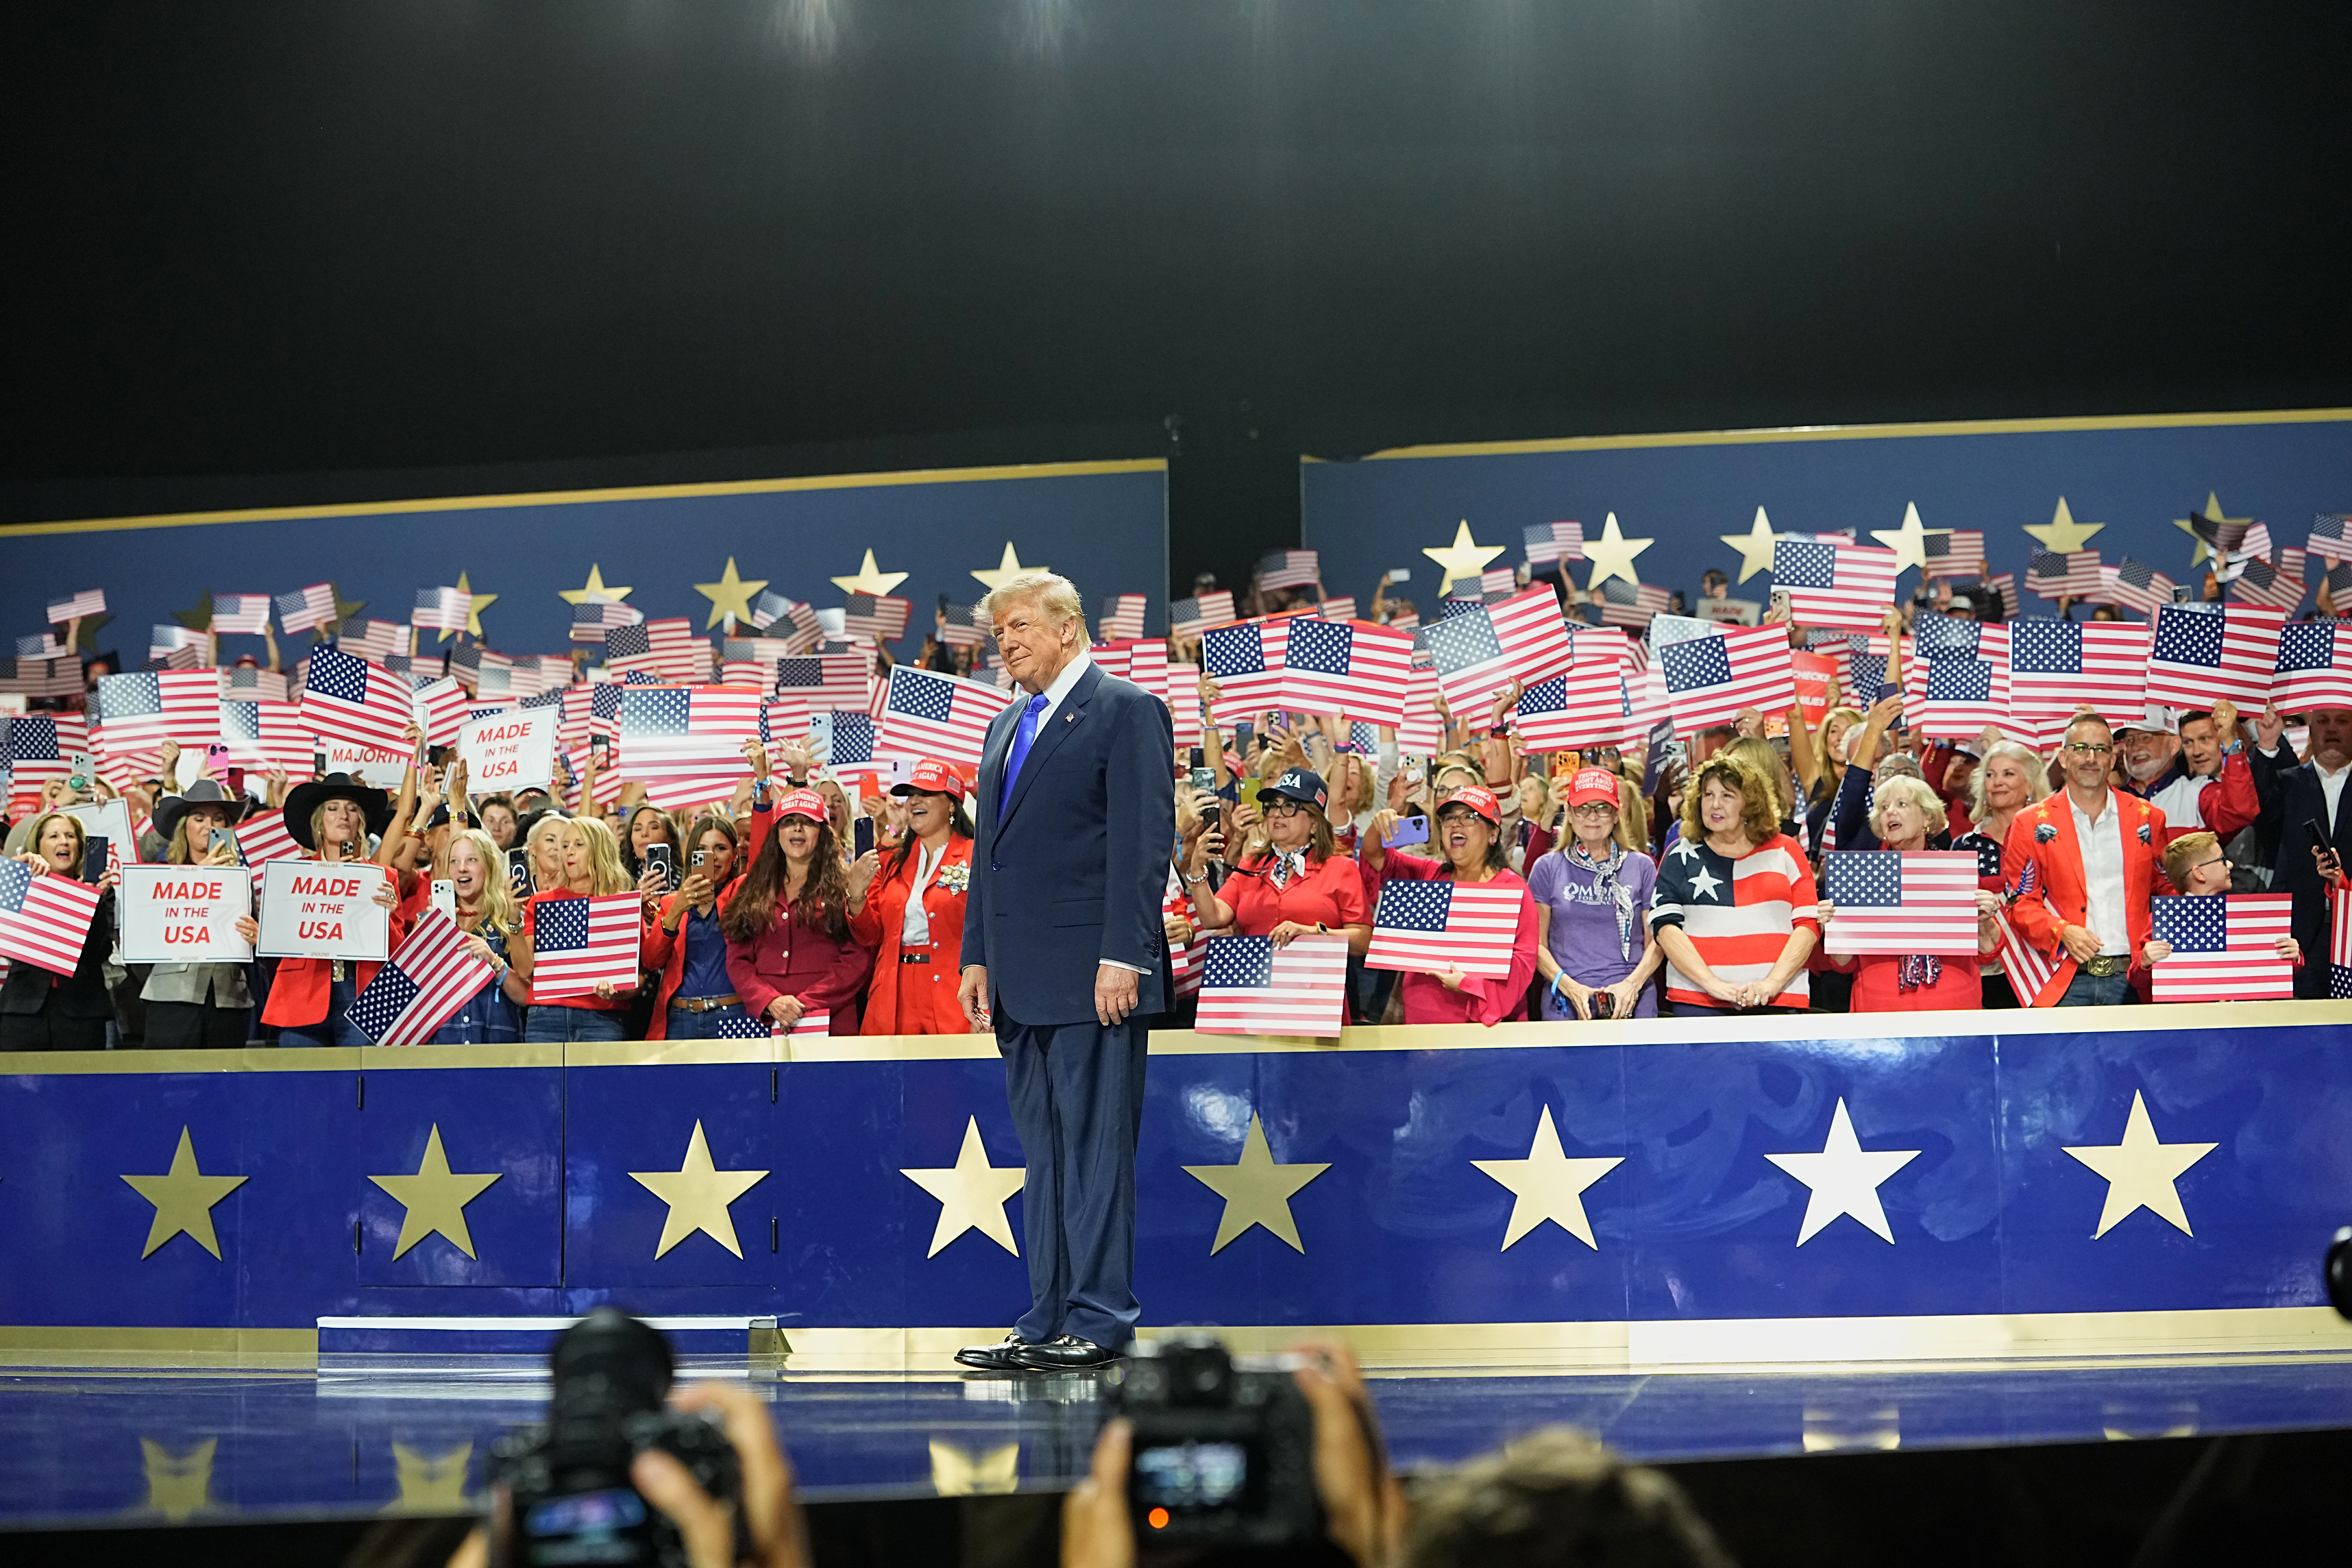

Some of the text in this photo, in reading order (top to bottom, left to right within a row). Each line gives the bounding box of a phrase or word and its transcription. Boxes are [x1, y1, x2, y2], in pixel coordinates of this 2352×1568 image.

[476, 722, 533, 744] MADE
[485, 745, 519, 757] IN THE
[482, 760, 517, 778] USA
[917, 763, 943, 774] AMERICA
[917, 772, 938, 782] AGAIN
[1575, 777, 1614, 788] RIGHT ABOUT
[1578, 771, 1612, 782] TRUMP WAS
[795, 792, 821, 805] AMERICA
[1463, 787, 1492, 802] AMERICA
[1465, 794, 1486, 808] AGAIN
[781, 800, 818, 811] GREAT AGAIN
[152, 882, 222, 899] MADE
[291, 877, 361, 897] MADE
[165, 907, 209, 917] IN THE
[302, 903, 344, 914] IN THE
[165, 926, 210, 944] USA
[298, 921, 343, 940] USA
